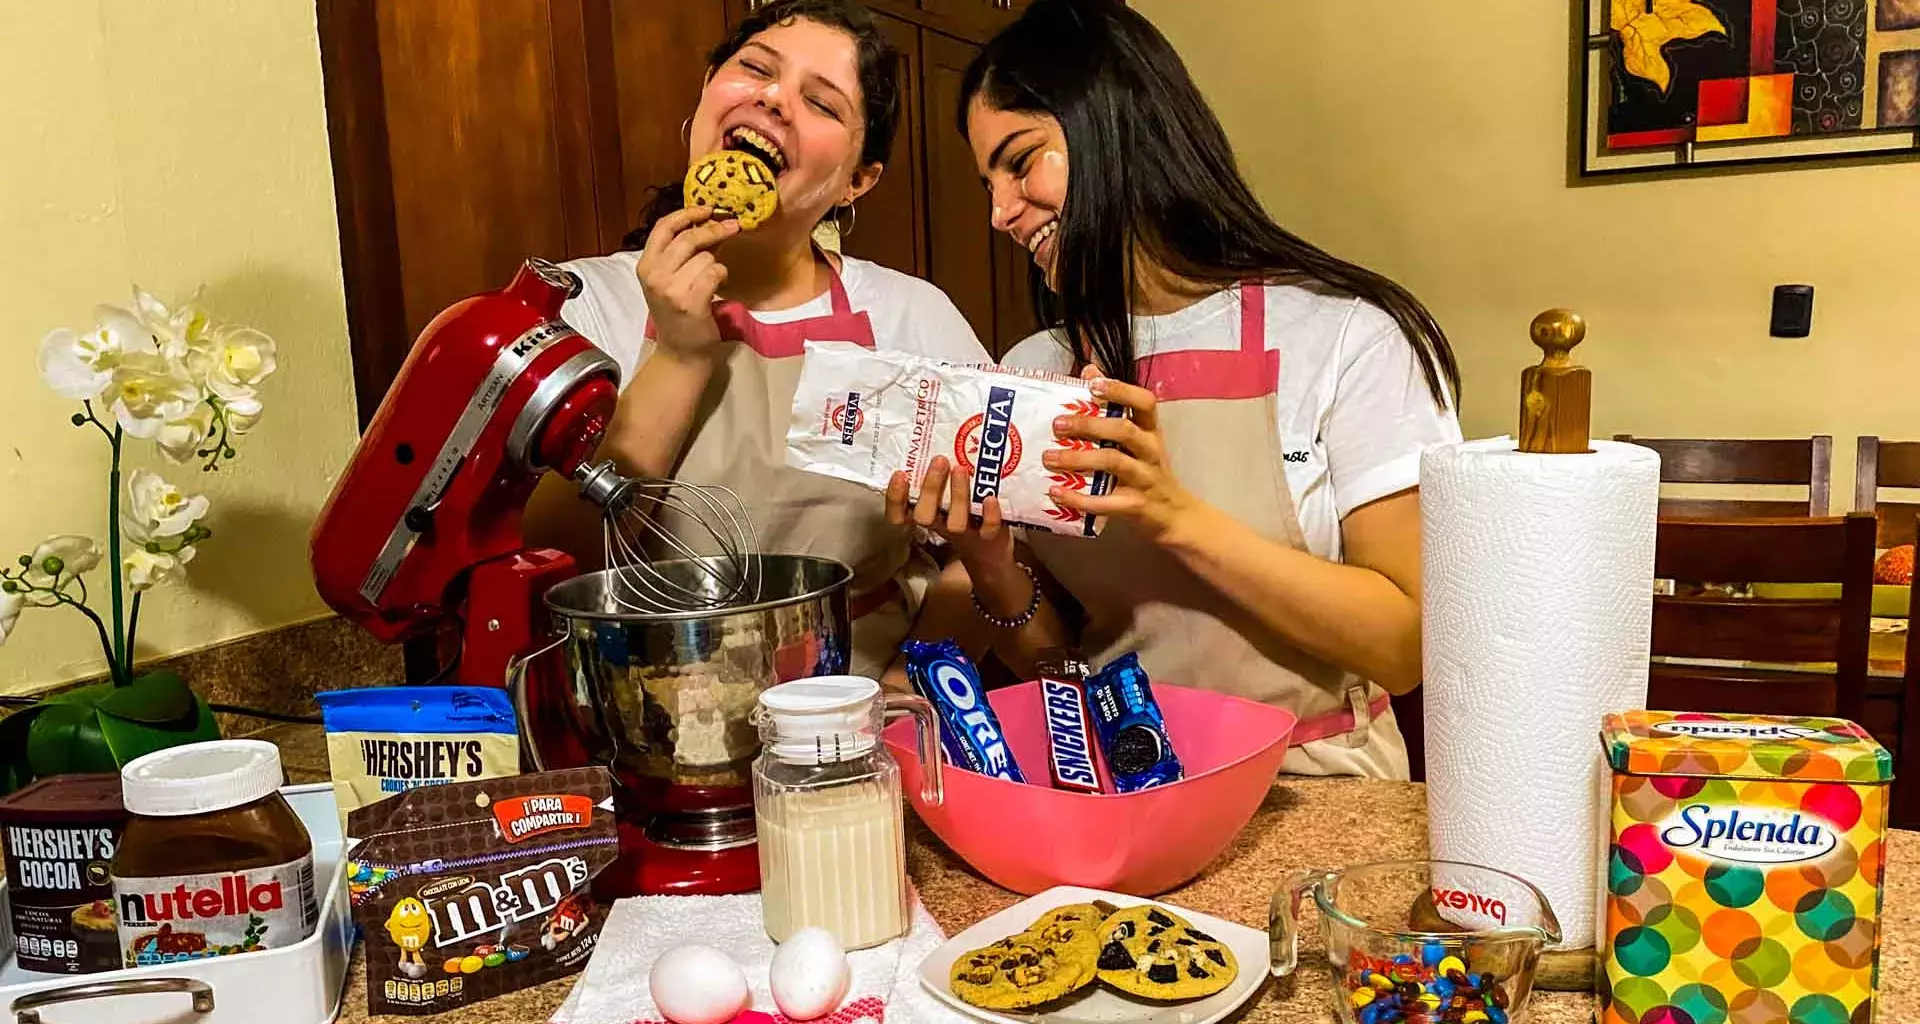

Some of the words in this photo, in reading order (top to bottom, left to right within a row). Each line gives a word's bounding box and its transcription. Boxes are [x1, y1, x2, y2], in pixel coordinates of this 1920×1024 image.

[842, 398, 859, 442] SELECTA
[976, 399, 1012, 502] SELECTA
[1046, 681, 1095, 786] SNICKERS
[1671, 726, 1820, 739] Splenda
[361, 740, 483, 779] HERSHEY'S
[9, 826, 114, 860] HERSHEY'S
[1661, 804, 1823, 849] Splenda
[19, 860, 82, 890] COCOA
[120, 875, 283, 921] nutella
